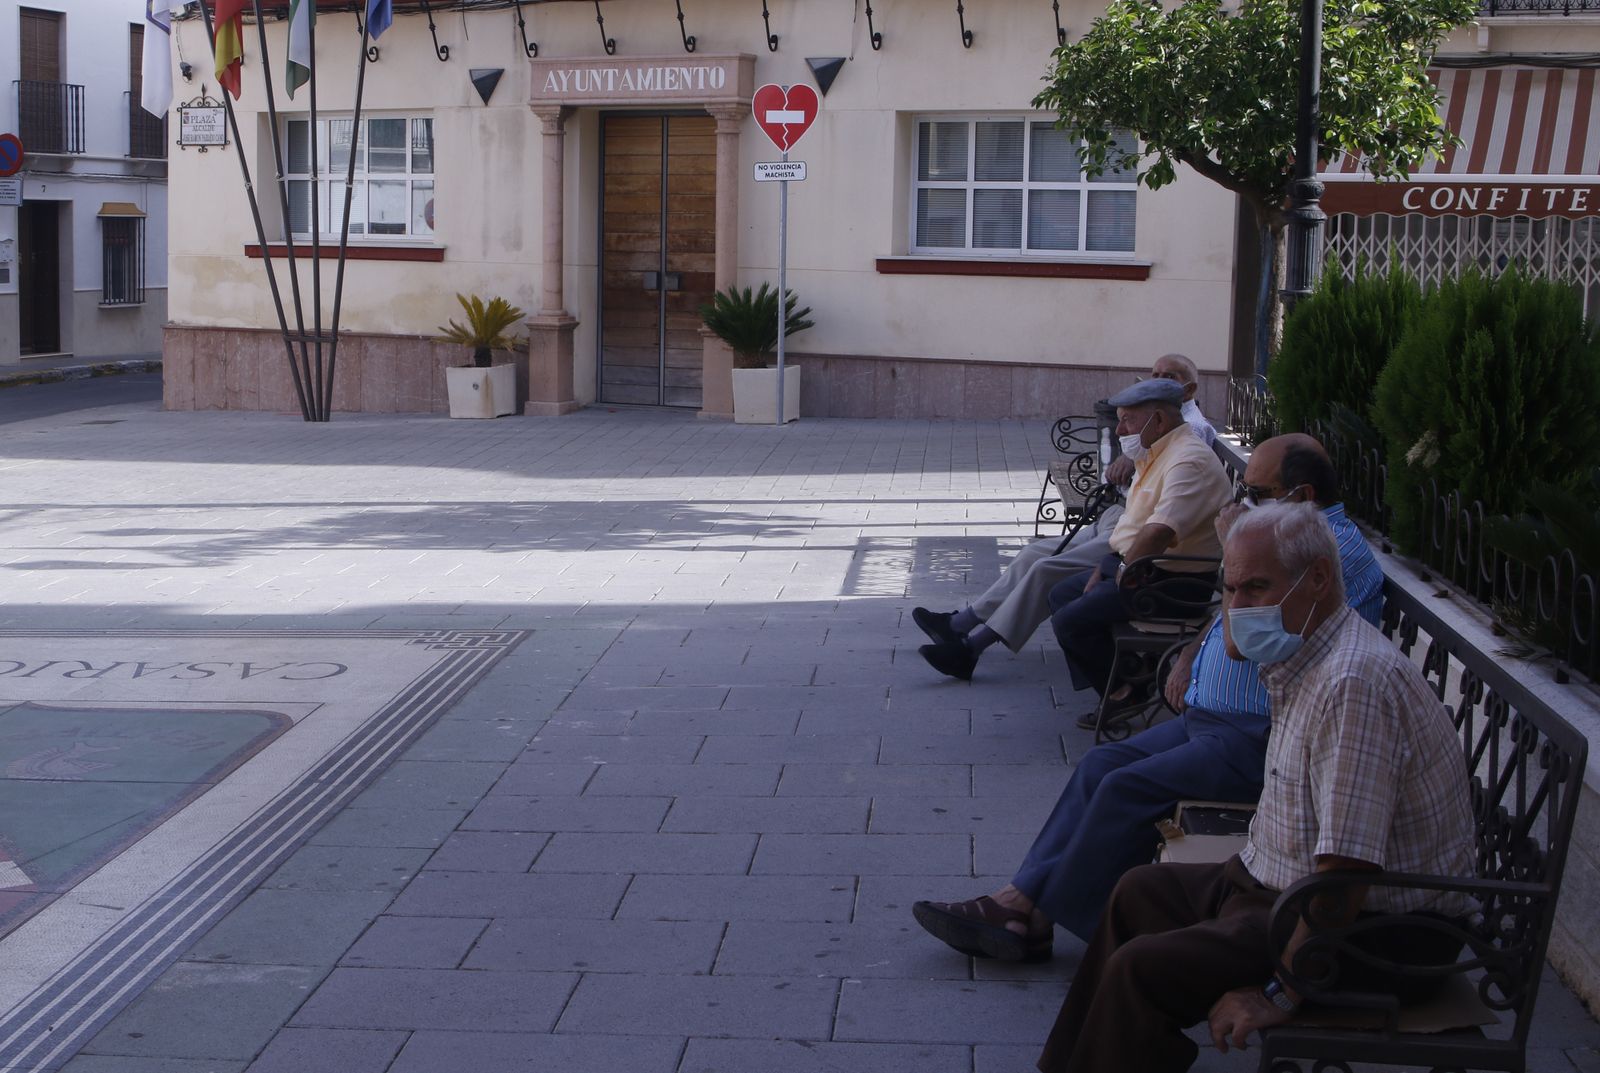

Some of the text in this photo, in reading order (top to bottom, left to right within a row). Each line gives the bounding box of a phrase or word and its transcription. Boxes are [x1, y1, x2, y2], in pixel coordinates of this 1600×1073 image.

[543, 65, 726, 93] AYUNTAMIENTO
[190, 115, 216, 124] PLAZA
[41, 184, 46, 192] 7
[1402, 186, 1600, 212] CONFITE
